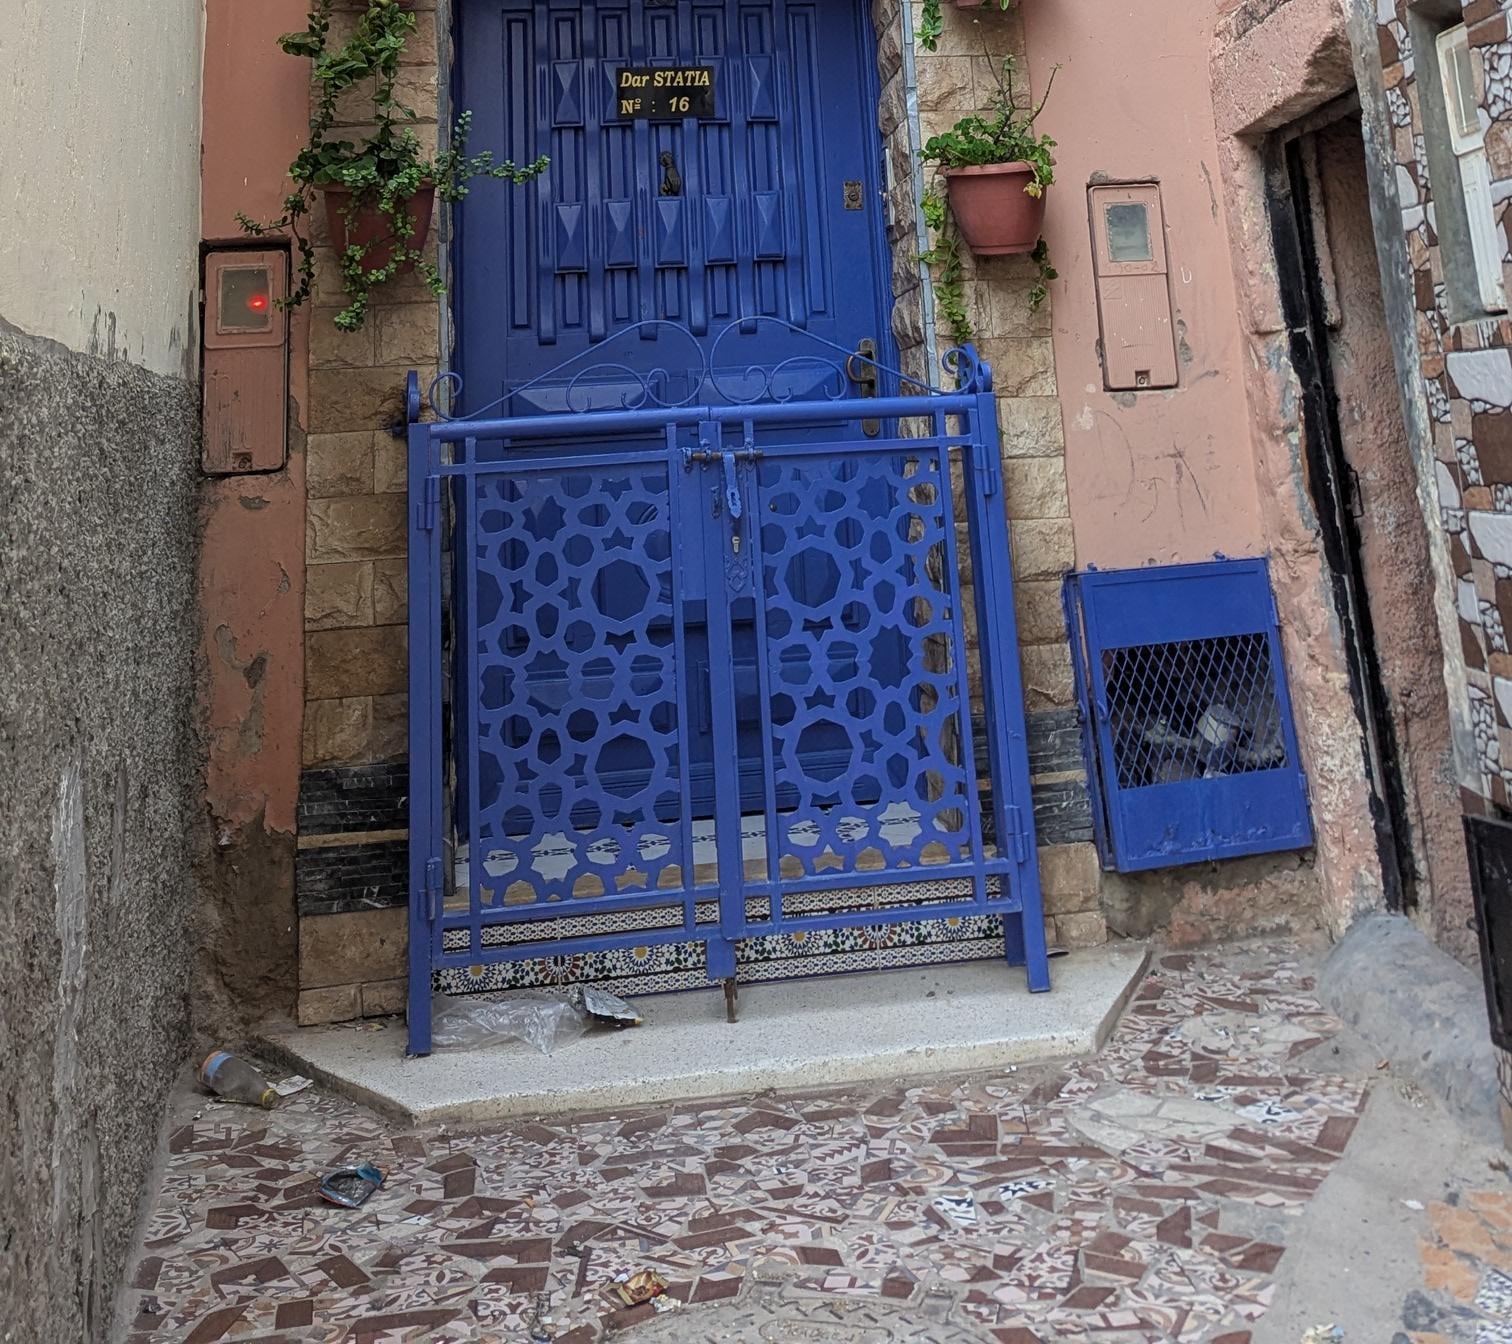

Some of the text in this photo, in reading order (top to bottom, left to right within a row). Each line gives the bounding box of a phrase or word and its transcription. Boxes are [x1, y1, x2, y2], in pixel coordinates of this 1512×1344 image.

[620, 71, 710, 87] Dar STATIA
[668, 96, 690, 112] 16
